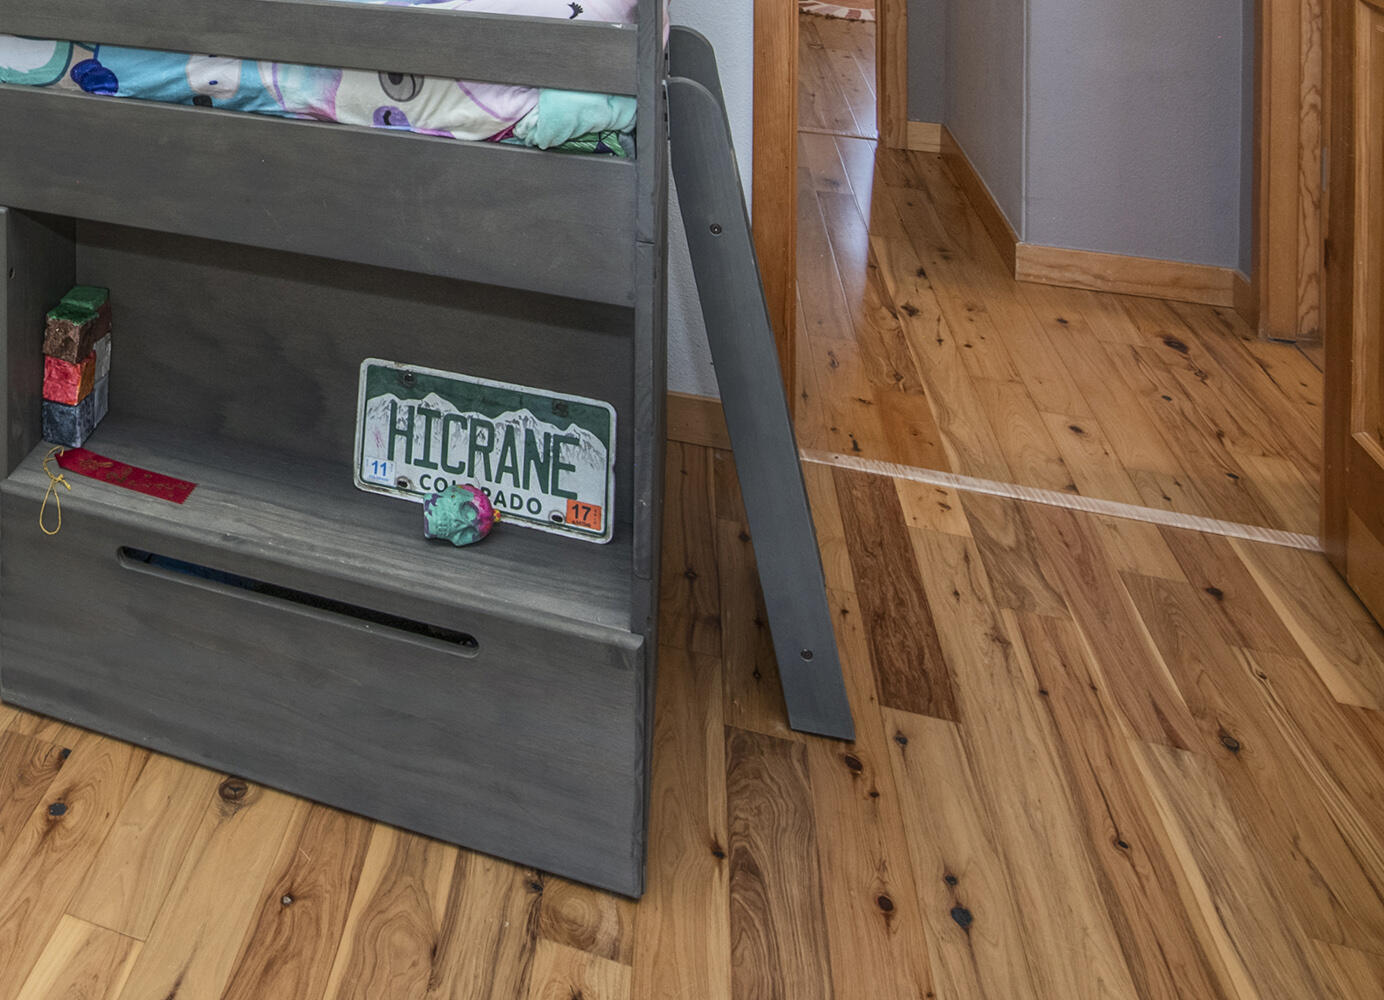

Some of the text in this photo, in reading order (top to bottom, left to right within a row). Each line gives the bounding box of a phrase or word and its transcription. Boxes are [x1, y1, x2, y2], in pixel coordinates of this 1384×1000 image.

[387, 399, 580, 500] HICRANE
[371, 460, 387, 477] 11
[571, 503, 591, 521] 17
